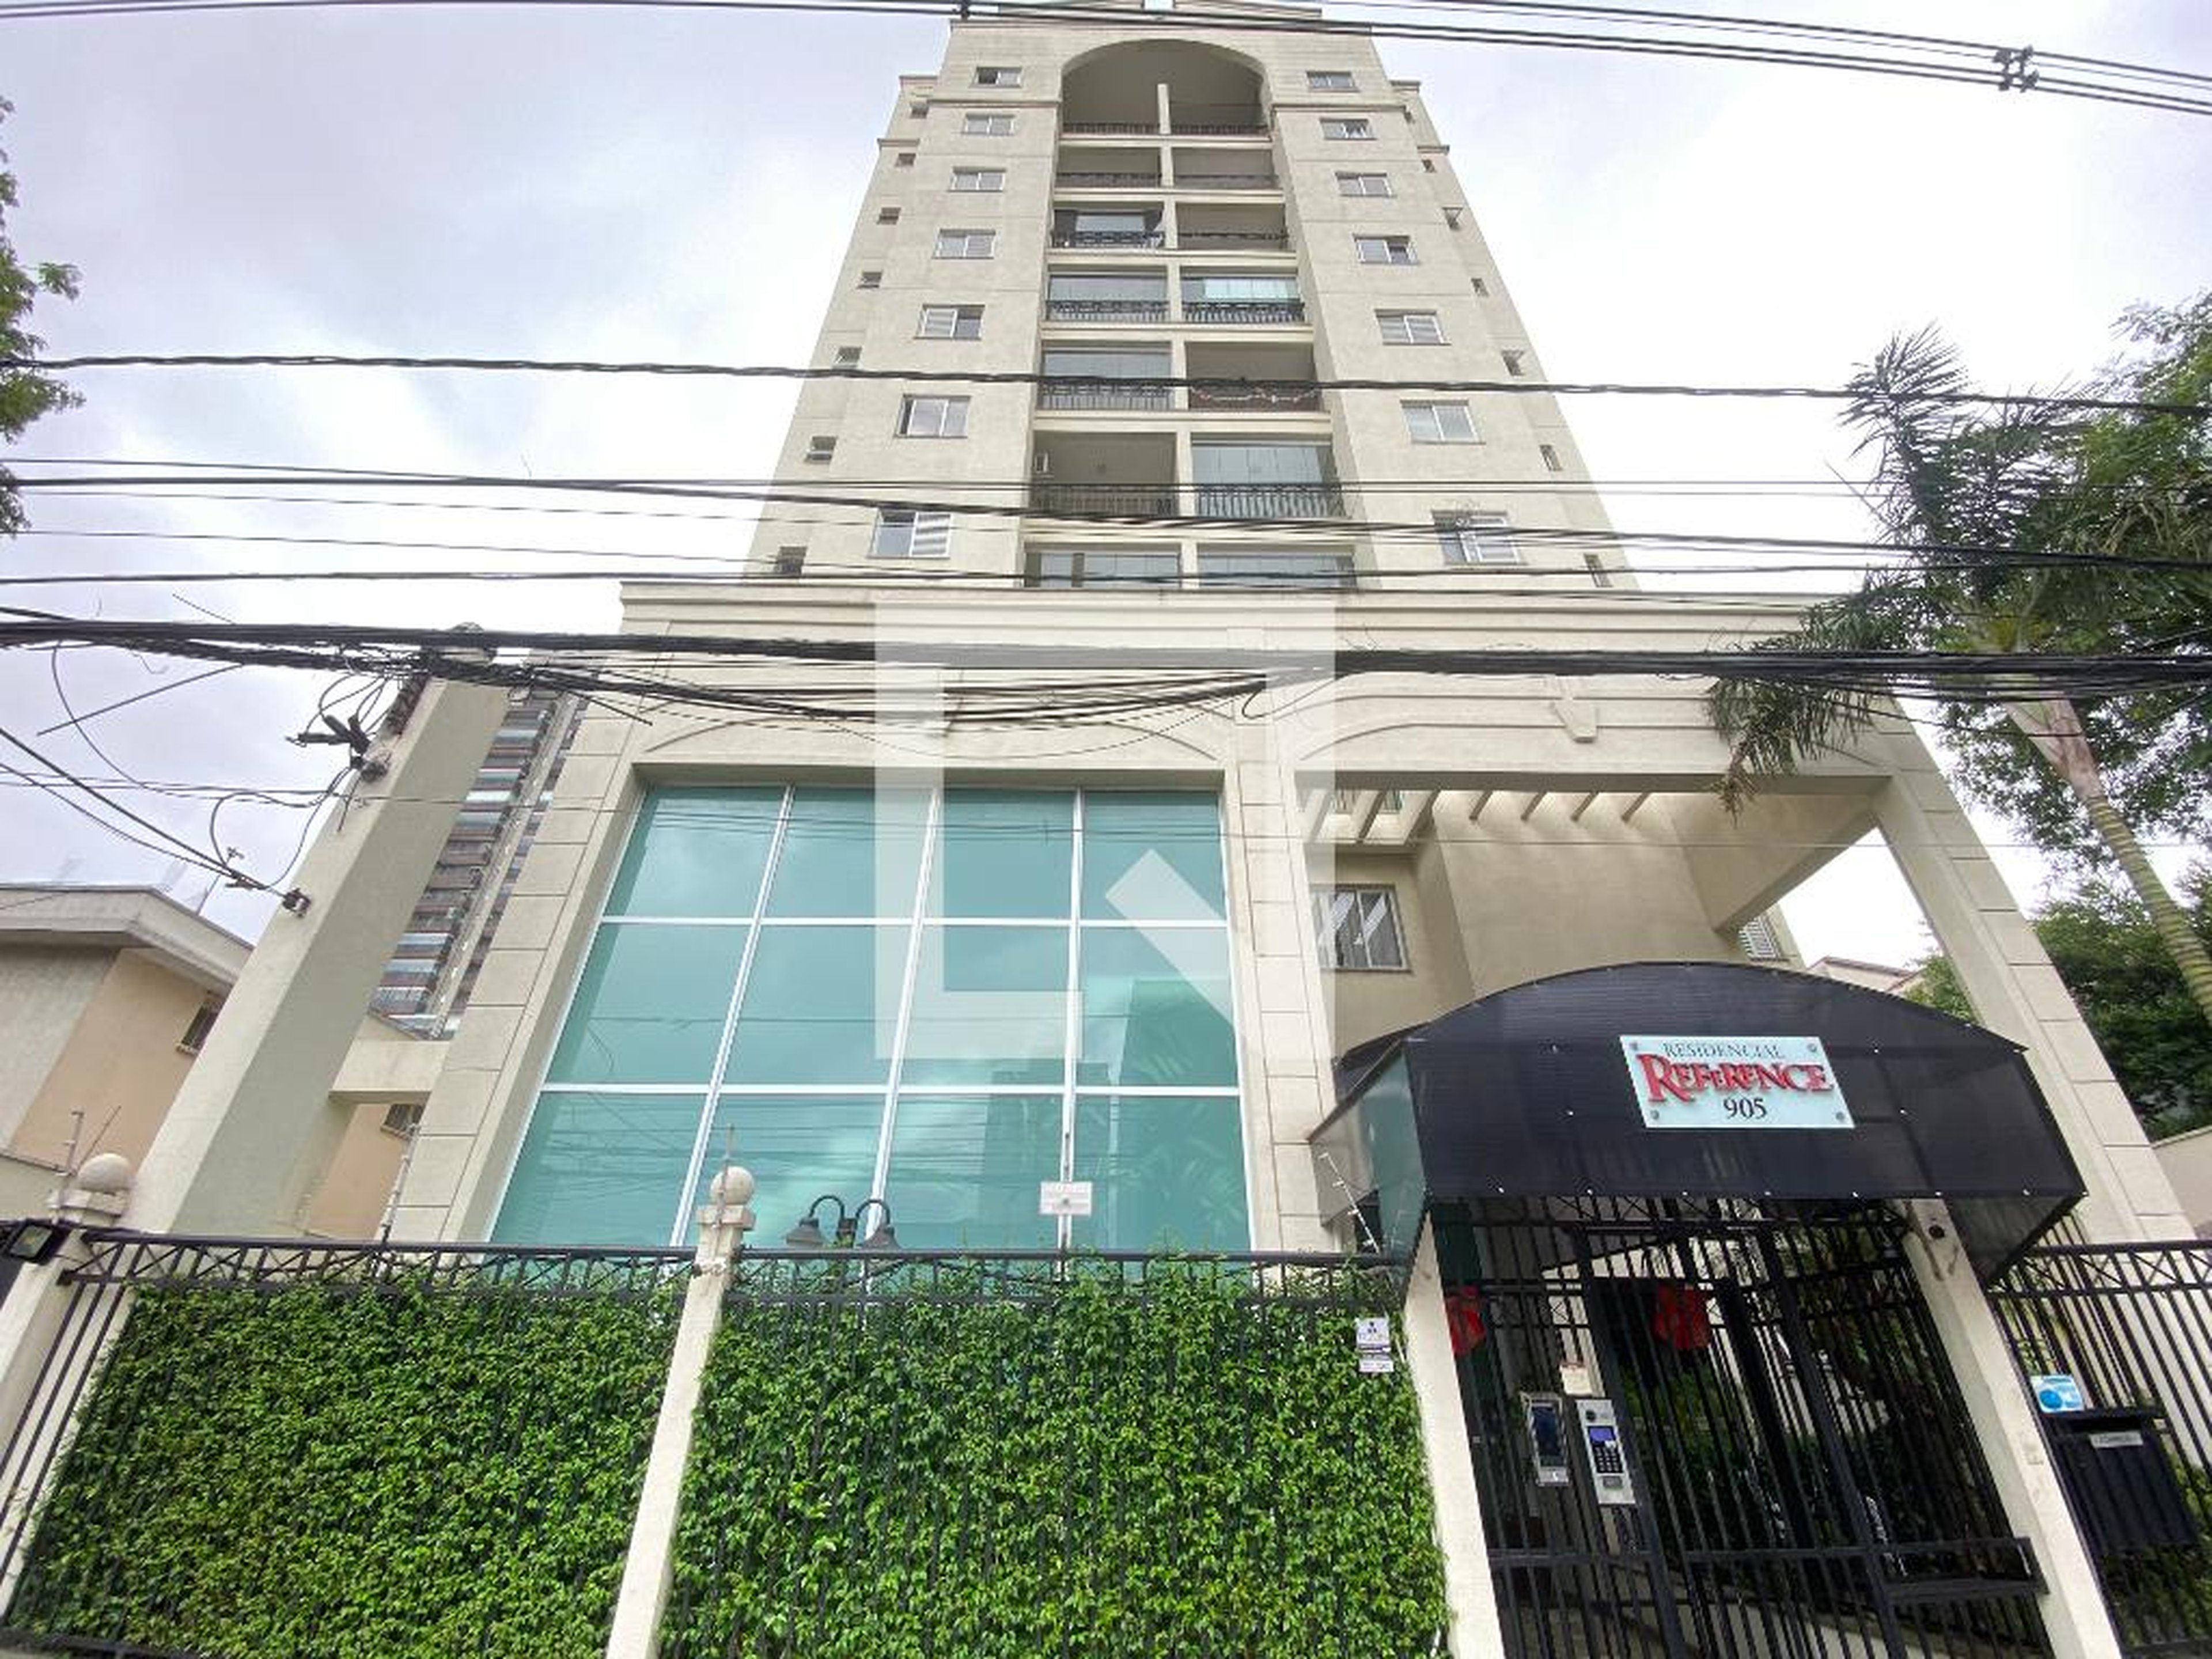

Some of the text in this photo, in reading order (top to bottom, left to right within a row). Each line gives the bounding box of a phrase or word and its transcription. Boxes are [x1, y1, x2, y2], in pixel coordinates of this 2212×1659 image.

[1664, 1043, 1784, 1058] RESIDENCIAL
[1637, 1054, 1834, 1102] REFERENCE
[1723, 1097, 1767, 1119] 905
